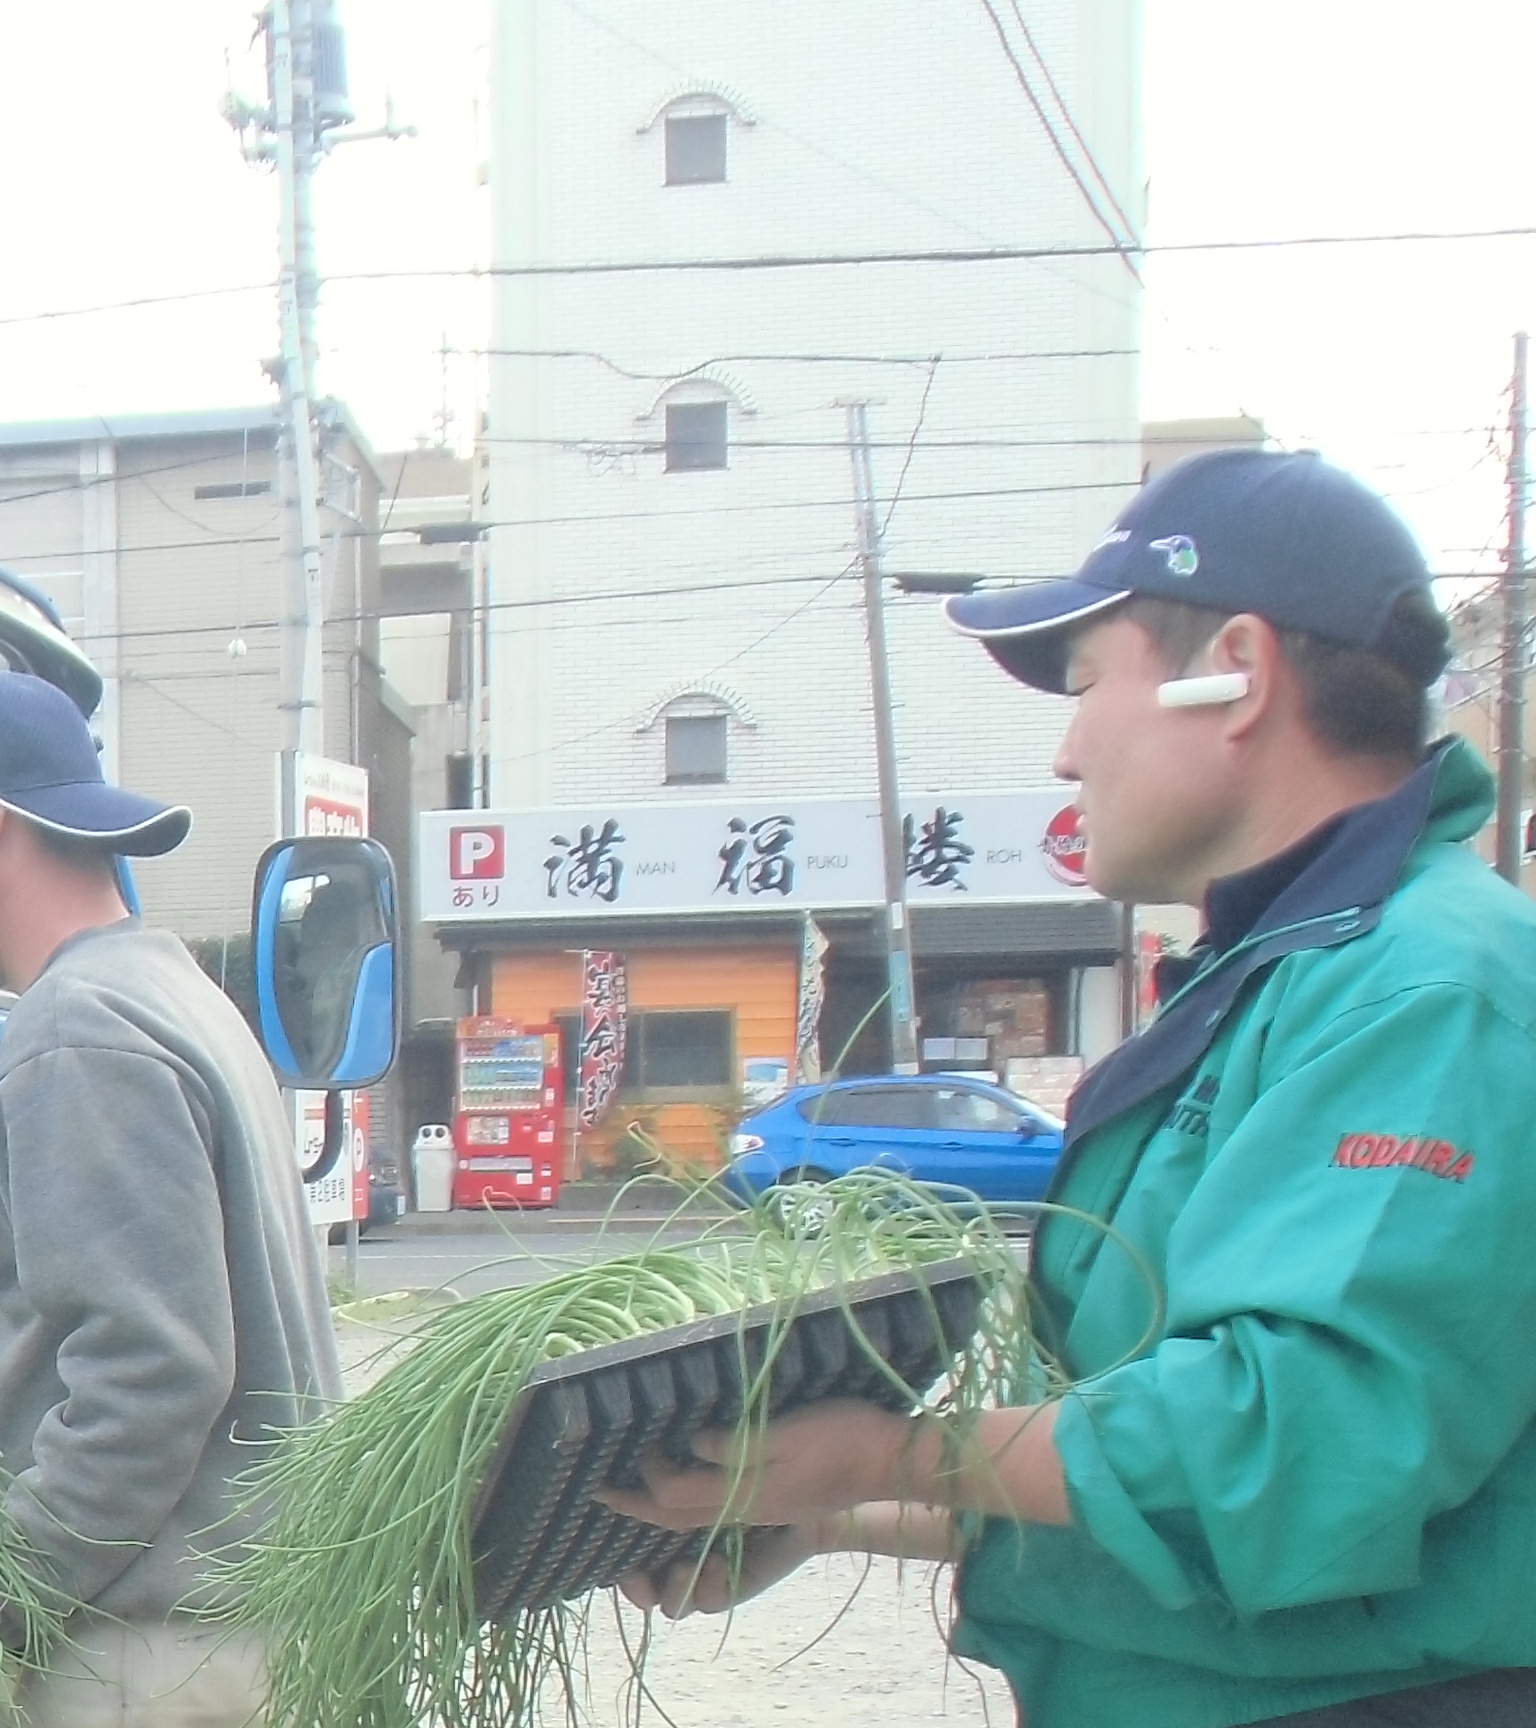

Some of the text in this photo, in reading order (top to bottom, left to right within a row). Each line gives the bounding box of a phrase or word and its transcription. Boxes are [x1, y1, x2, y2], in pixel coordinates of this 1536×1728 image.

[636, 862, 676, 876] MAN
[711, 814, 795, 897] 福
[986, 849, 1022, 864] ROH
[452, 884, 501, 908] あり
[1331, 1133, 1474, 1183] KODAIRA
